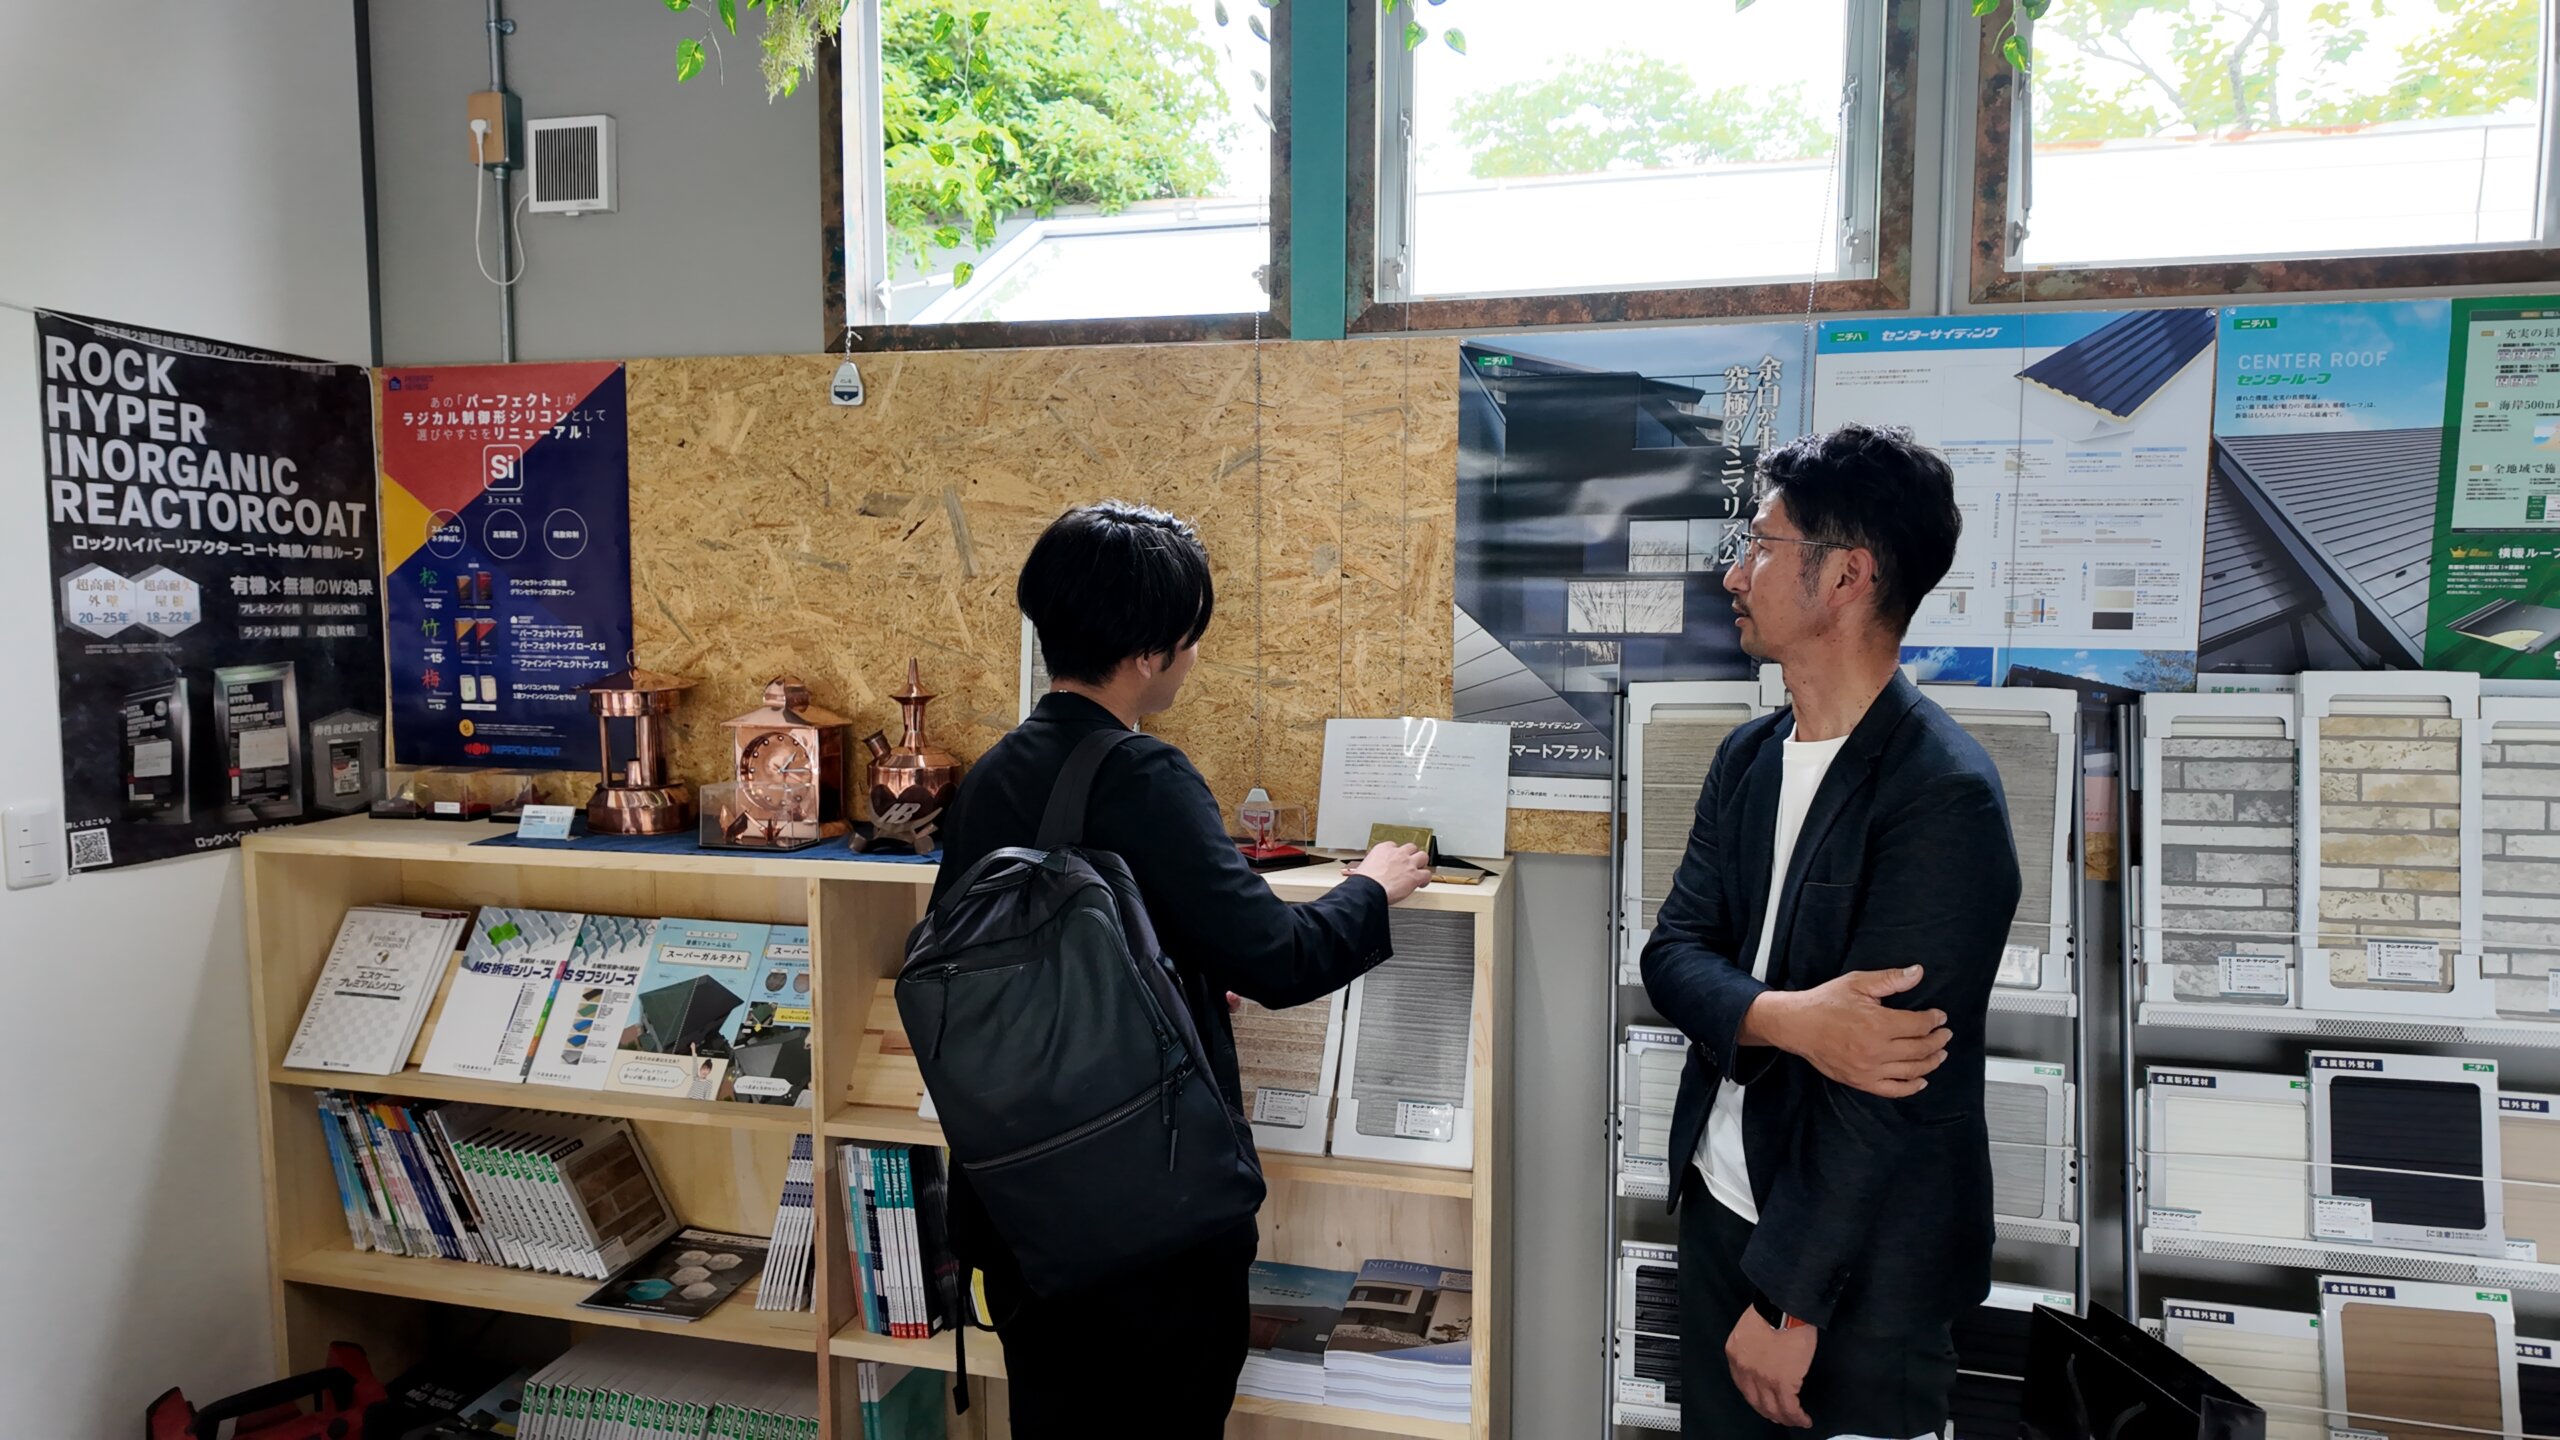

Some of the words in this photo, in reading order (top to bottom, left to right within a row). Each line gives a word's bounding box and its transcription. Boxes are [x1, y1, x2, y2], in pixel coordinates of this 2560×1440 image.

[2241, 319, 2271, 329] ニチハ
[1836, 332, 1863, 342] ニチハ
[1881, 327, 2002, 342] センターサイディング
[2506, 327, 2560, 339] 充実の長
[45, 335, 179, 397] ROCK
[1484, 357, 1508, 366] ニチハ
[2238, 352, 2322, 370] CENTER
[2330, 351, 2388, 368] ROOF
[2237, 373, 2331, 386] センタールーフ
[430, 393, 577, 409] あの「パーフェクト」が
[47, 385, 207, 445] HYPER
[402, 409, 606, 426] ラジカル制御形シリコンとして
[49, 433, 299, 495] INORGANIC
[491, 455, 514, 479] Si
[1720, 364, 1750, 566] 究極のミニマリズム
[2494, 463, 2560, 475] 全地域で施
[51, 481, 367, 538] REACTORCOAT
[420, 567, 438, 587] 松
[76, 578, 129, 591] 超高耐久
[143, 578, 193, 591] 超高耐久
[230, 575, 375, 597] 有機×無機のW効果
[421, 618, 440, 637] 竹
[422, 668, 440, 689] 梅
[1510, 721, 1583, 730] センターサイディング
[492, 745, 529, 755] NIPPON
[531, 746, 560, 756] PAINT
[1509, 744, 1605, 760] マートフラット
[666, 950, 742, 963] スーパーガルテクト
[359, 971, 391, 980] エスケー
[2320, 1058, 2375, 1069] 金属製外壁材
[2157, 1075, 2208, 1086] 金属製外壁材
[2499, 1100, 2541, 1111] 製外壁材
[1367, 1261, 1430, 1274] NICHIHA
[2331, 1284, 2387, 1297] 金属製外壁材
